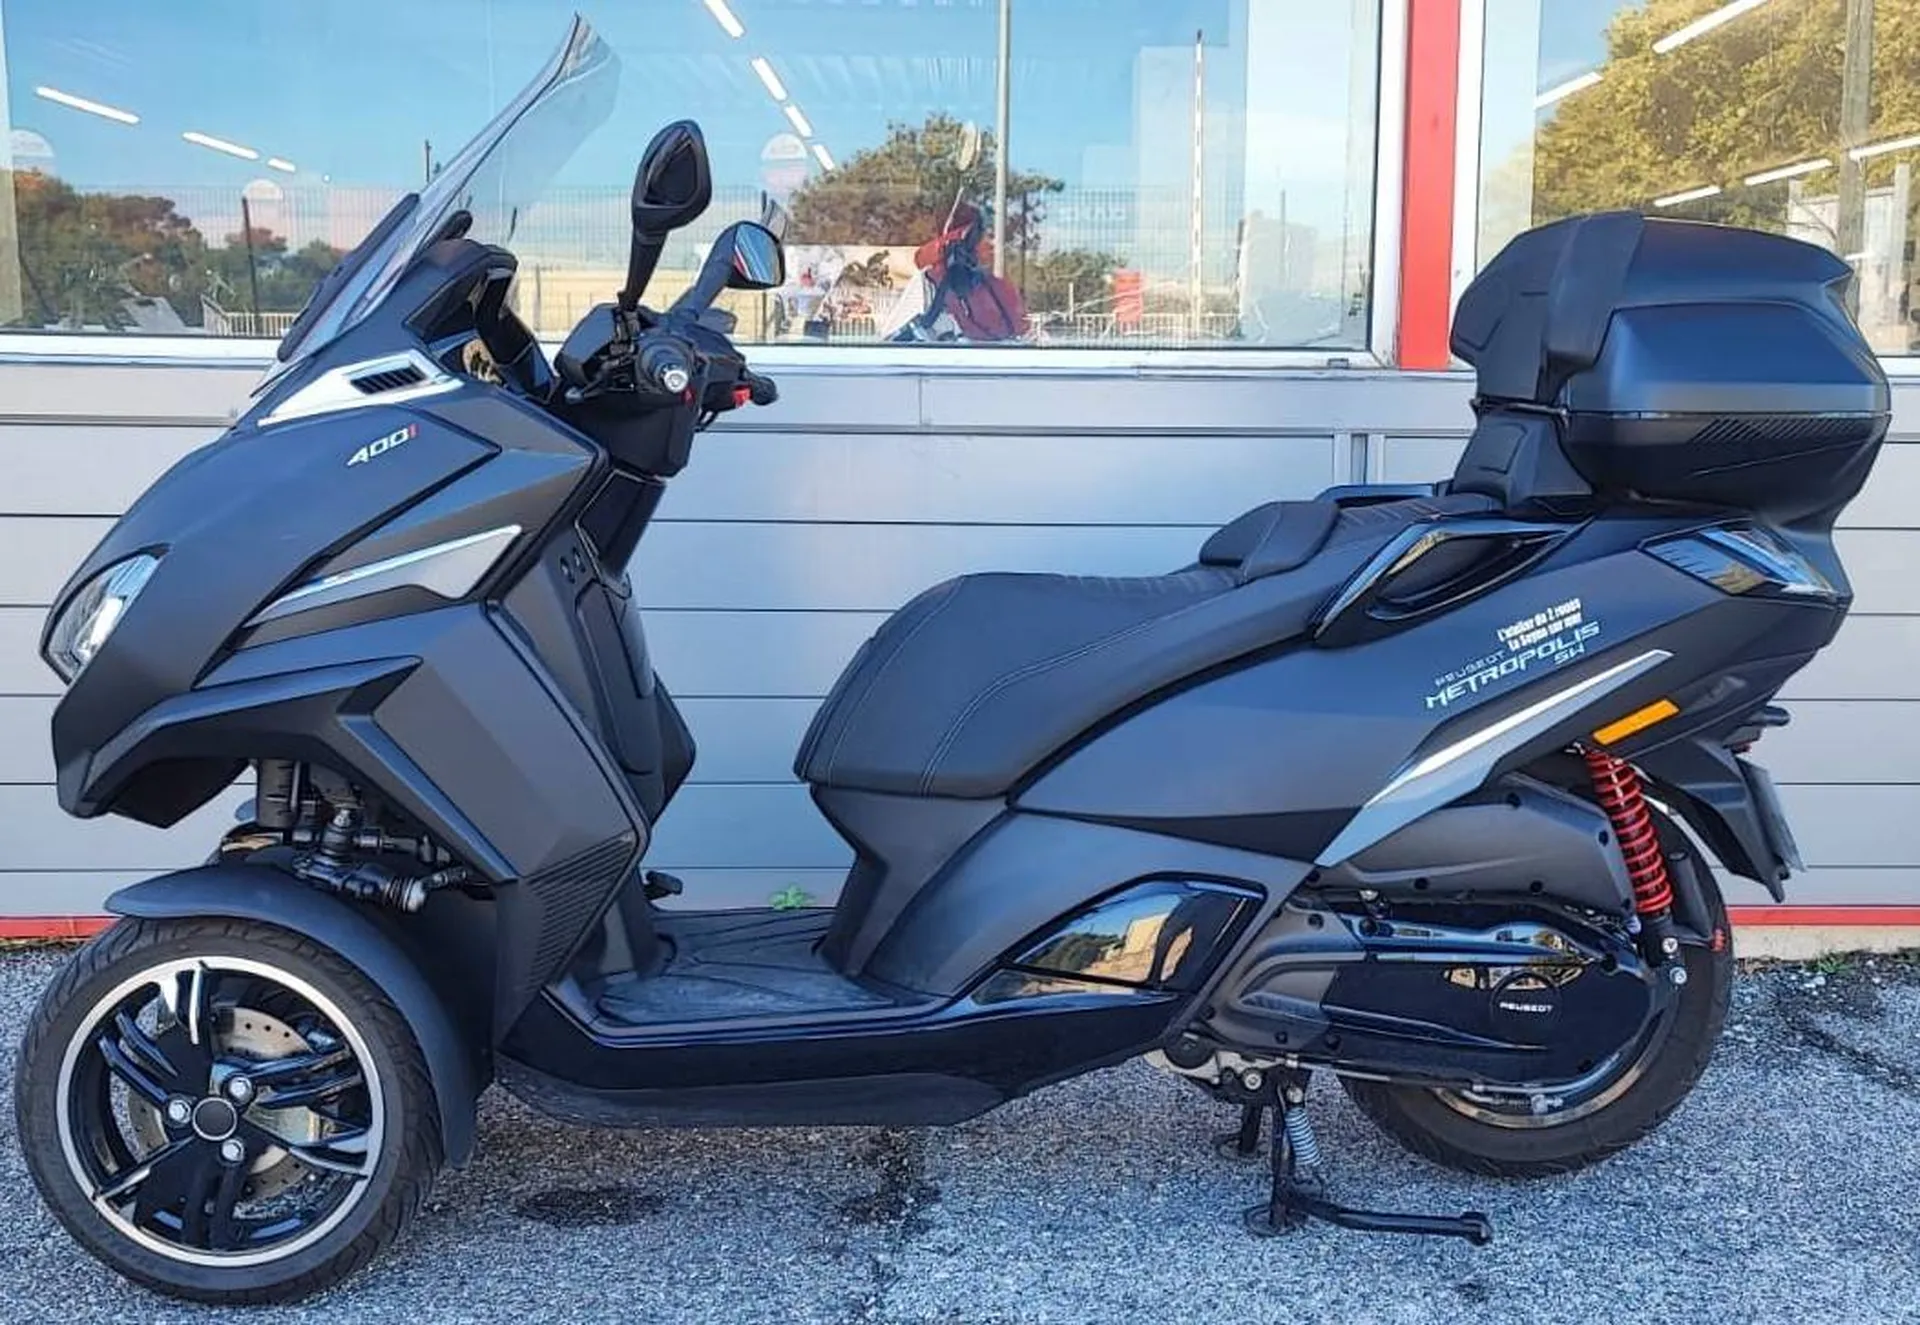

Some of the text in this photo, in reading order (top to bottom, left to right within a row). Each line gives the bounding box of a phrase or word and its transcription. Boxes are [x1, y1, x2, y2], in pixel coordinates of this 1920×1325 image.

[1425, 621, 1600, 709] METROPOLIS
[1435, 650, 1505, 687] PEUGEOT
[1554, 642, 1585, 666] SW
[1499, 1001, 1553, 1013] PEUGEOT
